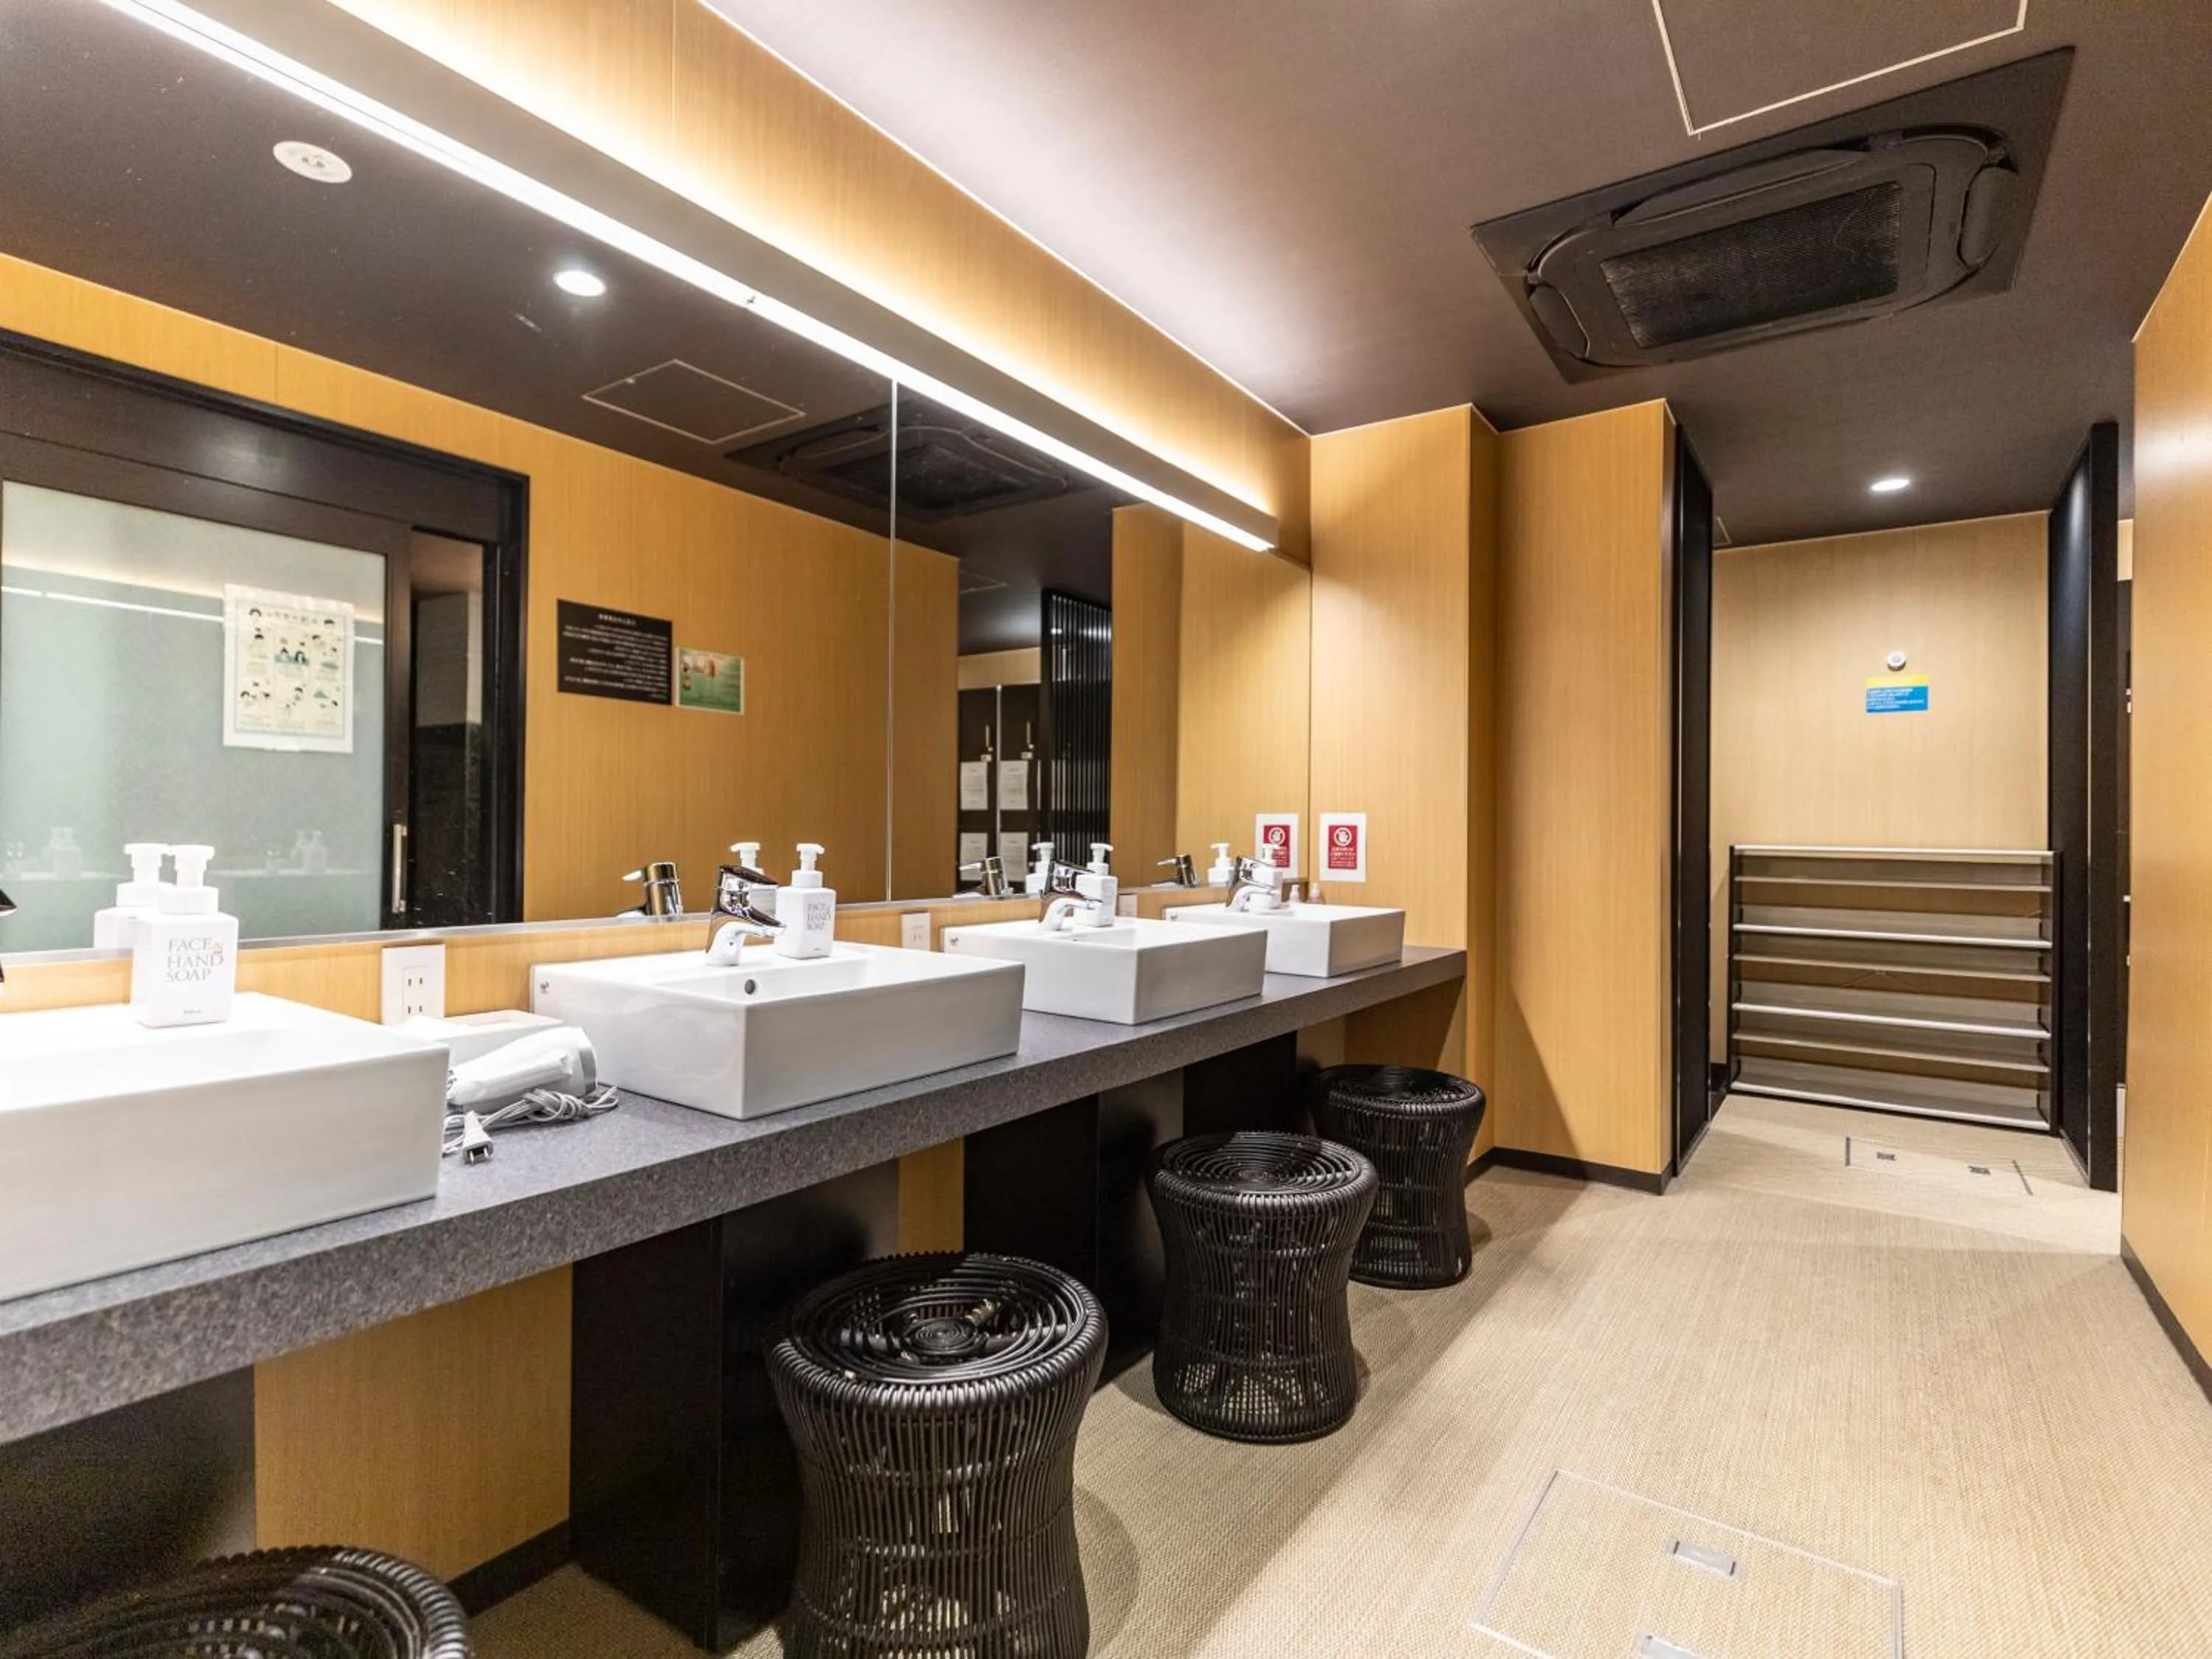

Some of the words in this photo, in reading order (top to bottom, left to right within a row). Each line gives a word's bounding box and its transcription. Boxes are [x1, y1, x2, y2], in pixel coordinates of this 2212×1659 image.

[168, 937, 212, 951] FACE
[167, 954, 224, 968] HAND
[166, 967, 212, 983] SOAP
